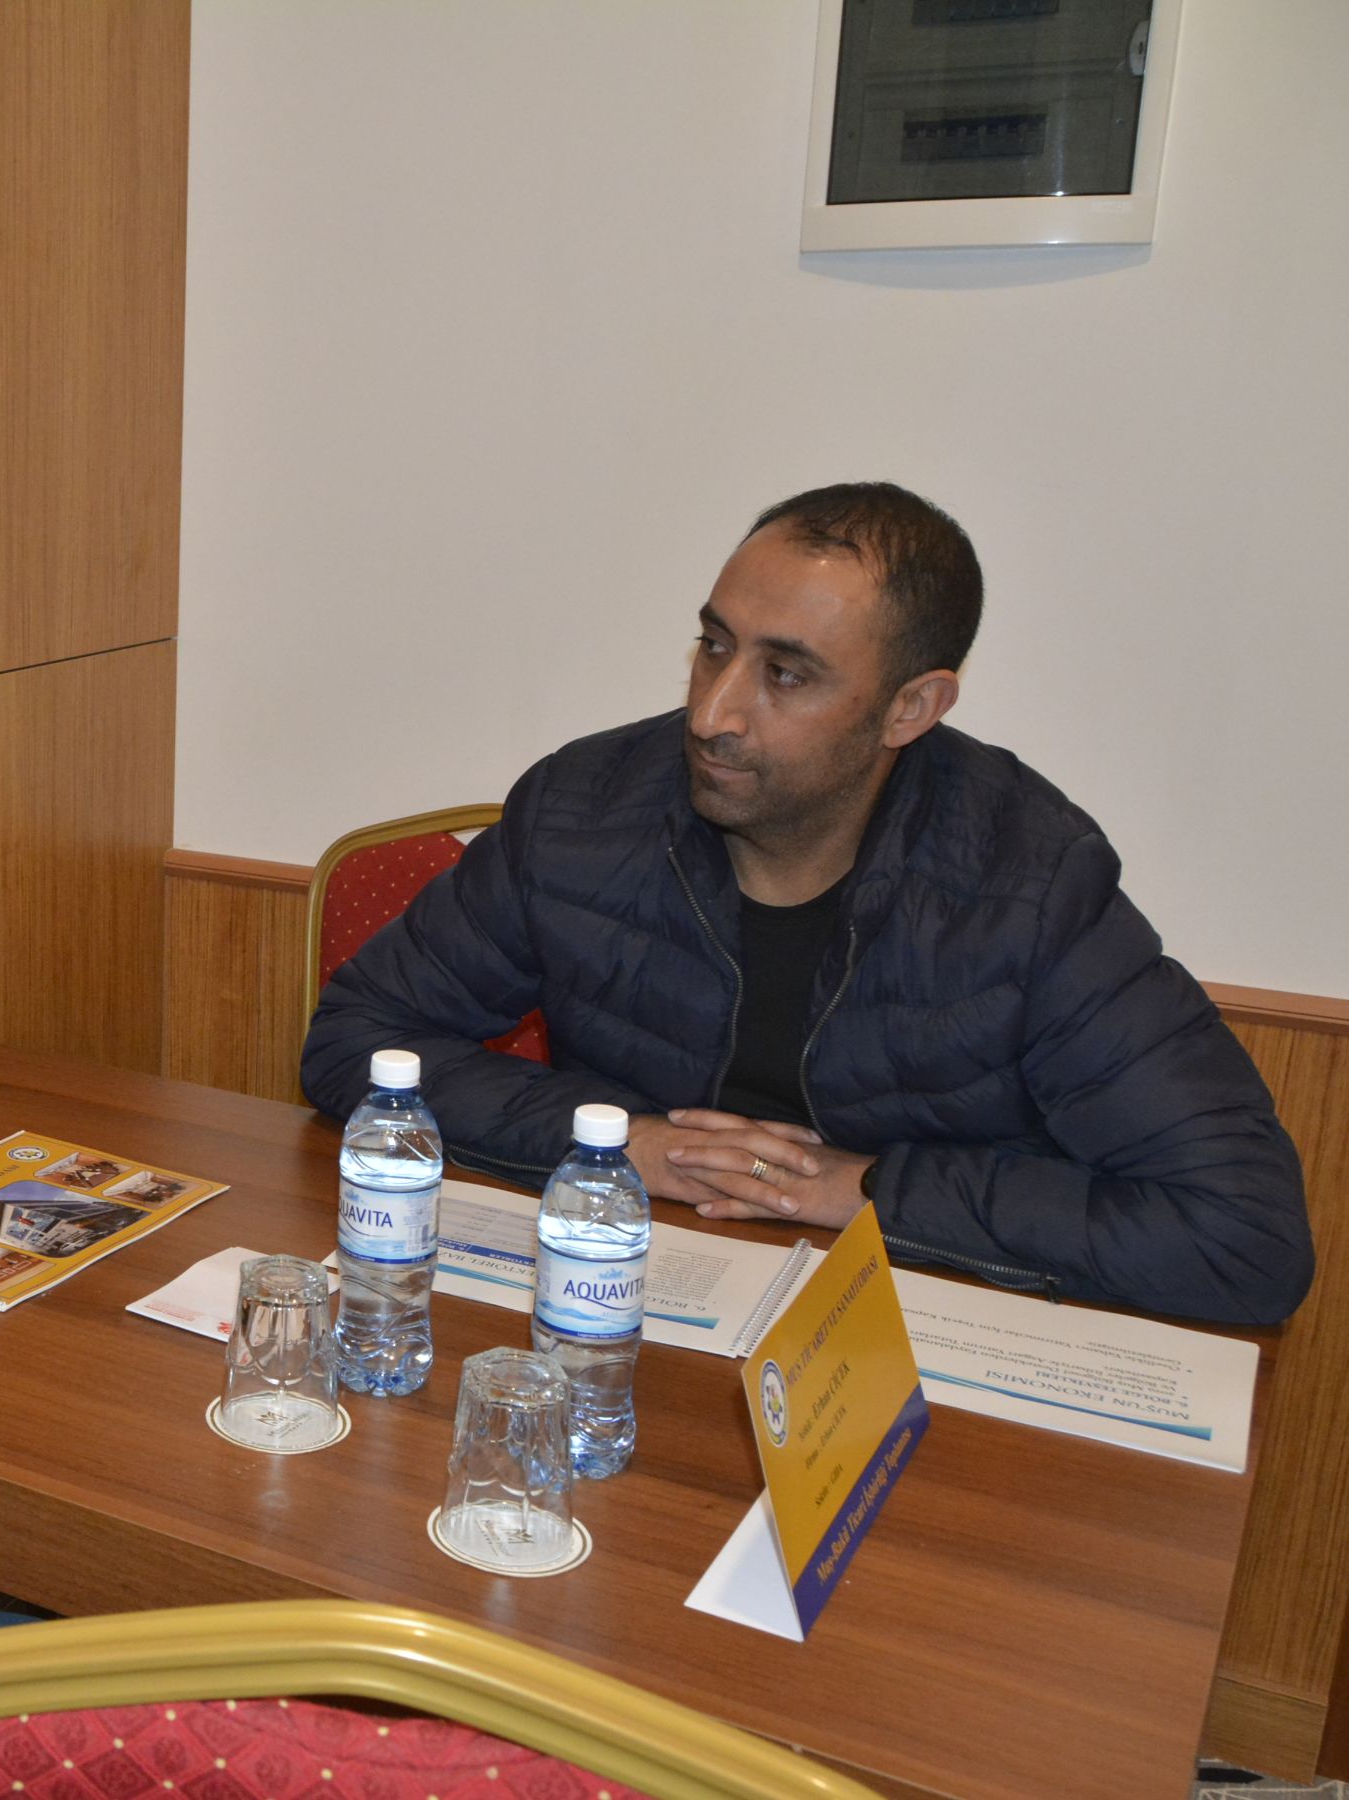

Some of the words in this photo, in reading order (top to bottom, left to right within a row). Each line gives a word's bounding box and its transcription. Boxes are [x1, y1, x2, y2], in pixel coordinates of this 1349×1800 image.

[339, 1197, 393, 1228] UAVITA
[471, 1258, 535, 1277] EKTÖREL
[489, 1254, 535, 1267] EKTÖRLER
[563, 1276, 645, 1300] AQUAVITA
[644, 1296, 688, 1309] BÖLG
[985, 1369, 1104, 1402] EKONOMİSİ
[1035, 1370, 1116, 1393] TEŞVİKLERİ
[1121, 1389, 1171, 1404] BÖLGE
